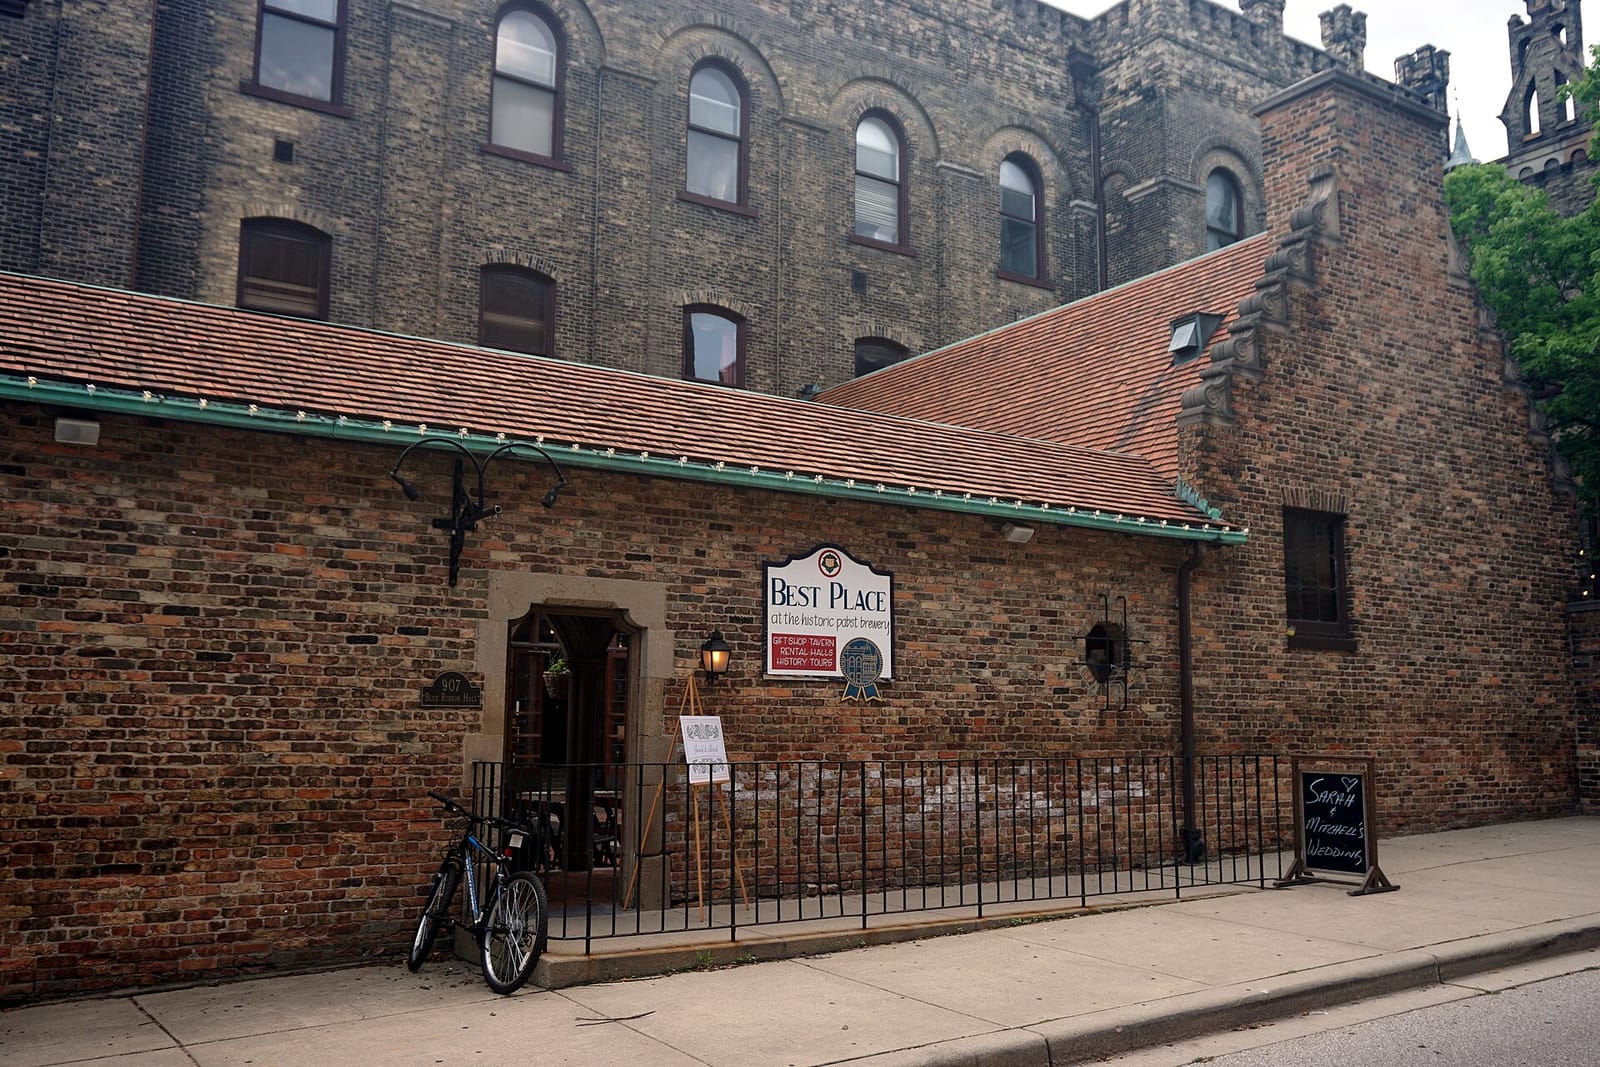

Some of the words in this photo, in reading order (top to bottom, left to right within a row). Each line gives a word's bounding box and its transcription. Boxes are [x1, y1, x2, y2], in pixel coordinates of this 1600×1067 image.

[771, 577, 821, 608] BEST
[829, 582, 886, 612] PLACE
[771, 613, 782, 625] at
[784, 612, 800, 626] the
[801, 613, 834, 627] historic
[837, 616, 858, 632] pabst
[860, 616, 890, 636] brewery
[809, 638, 834, 647] TAVERN
[780, 647, 808, 655] RENTAL
[810, 648, 833, 657] HALLS
[776, 657, 807, 666] HISTORY
[810, 658, 833, 667] TOURS
[441, 679, 461, 692] 907
[1305, 778, 1355, 807] SARAH
[1329, 806, 1337, 817] &
[1307, 838, 1363, 866] WEDDING
